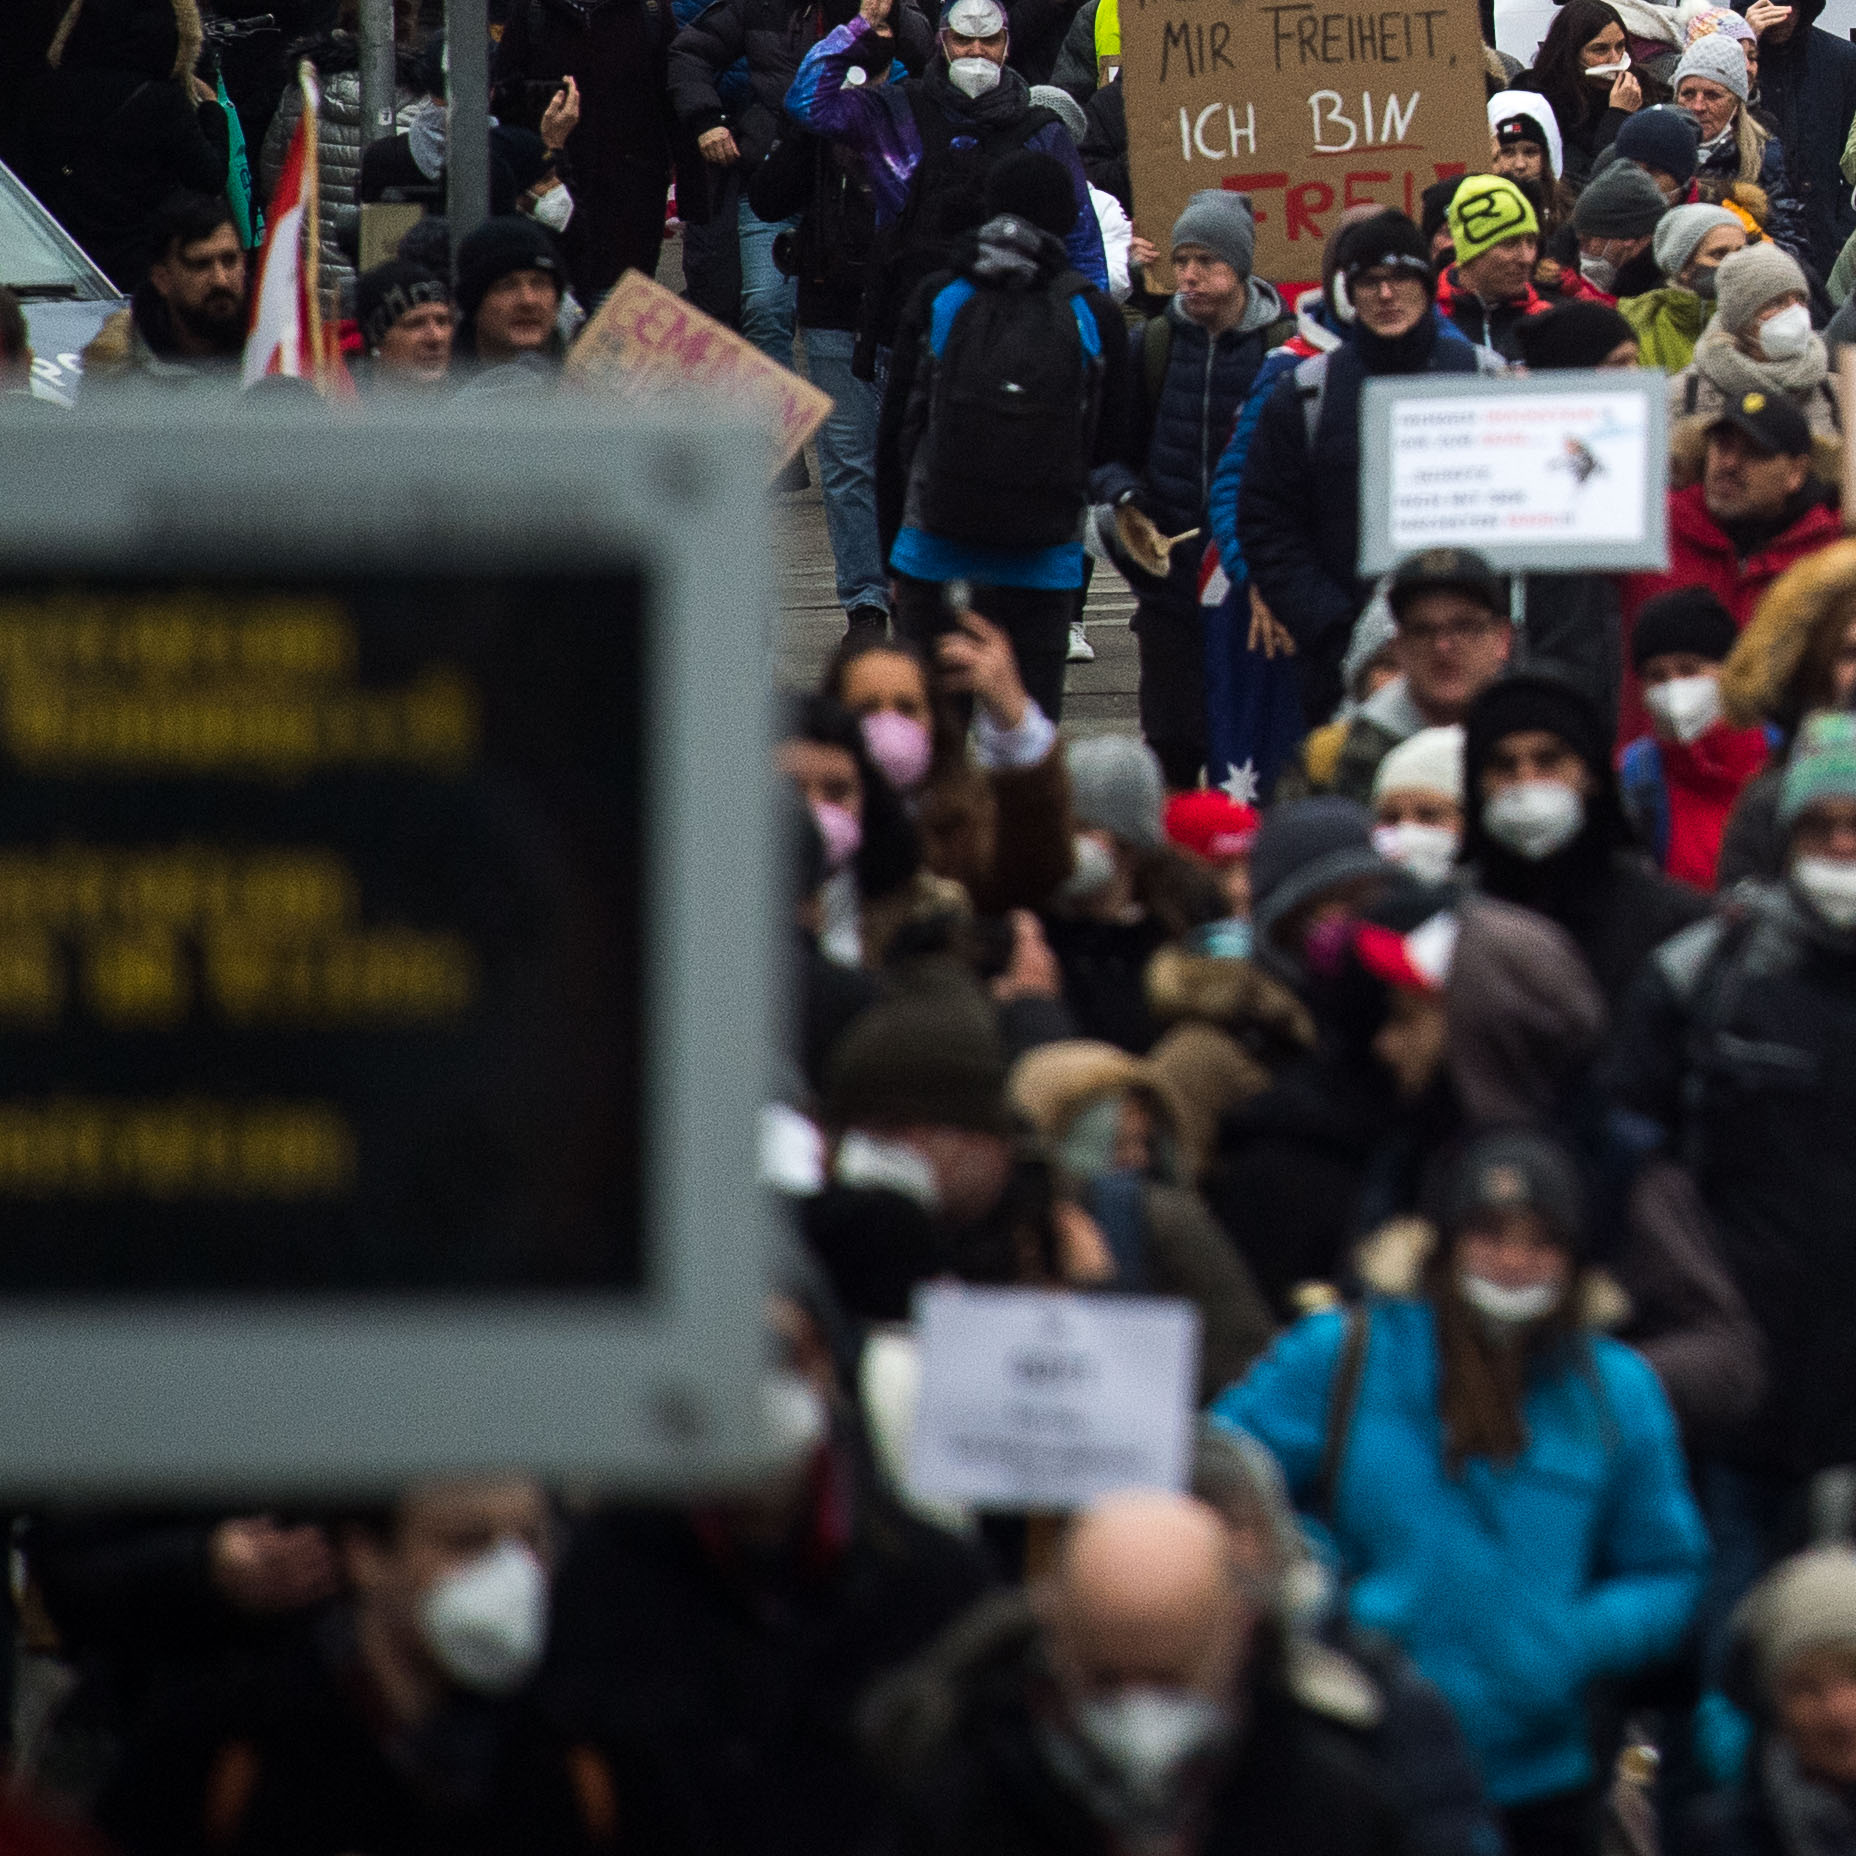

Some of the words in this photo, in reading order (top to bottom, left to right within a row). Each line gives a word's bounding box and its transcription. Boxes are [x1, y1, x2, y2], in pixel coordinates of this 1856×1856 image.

[1159, 19, 1236, 84] MIR
[1179, 101, 1257, 162] ICH
[1307, 89, 1421, 154] BIN
